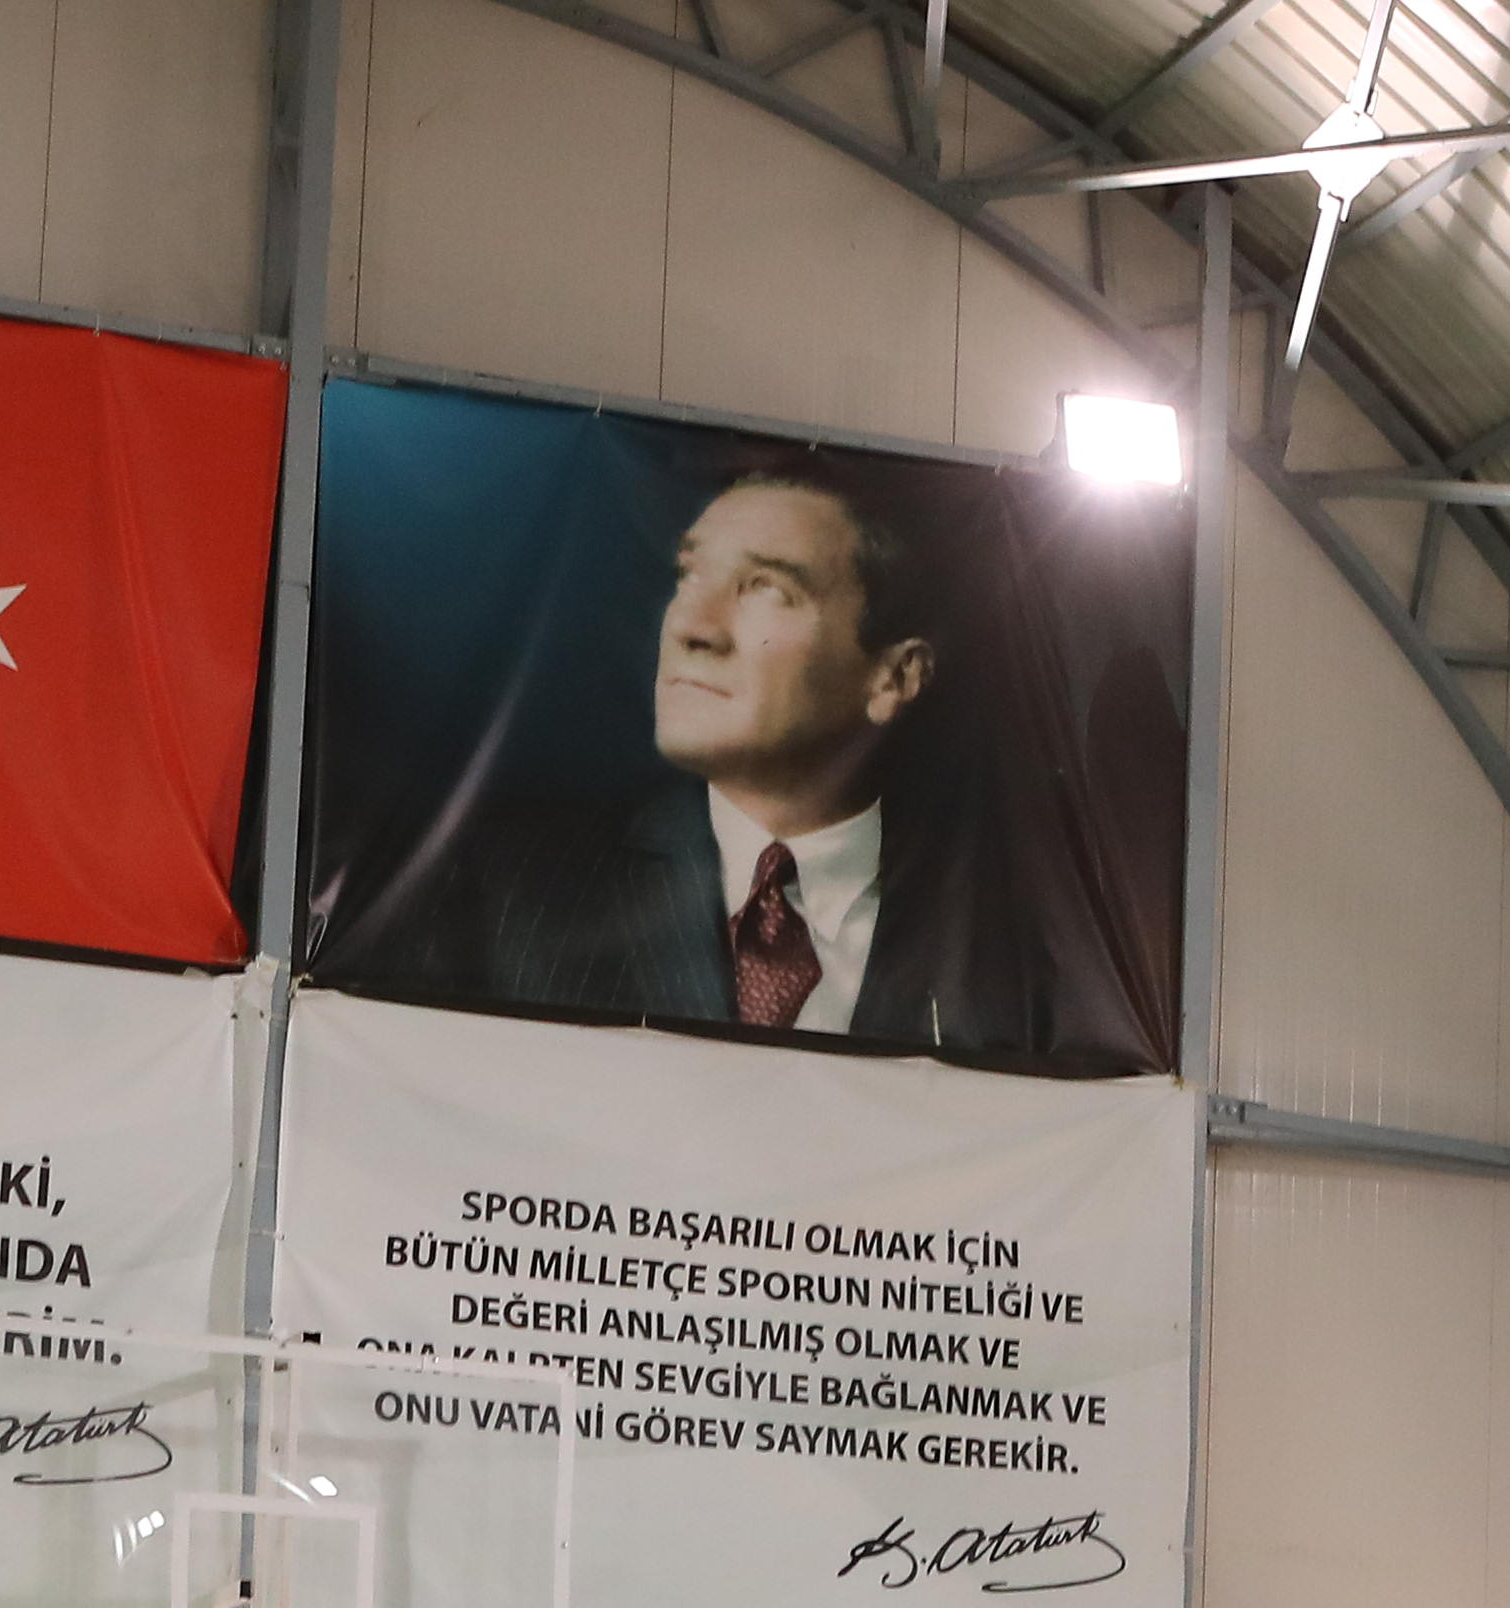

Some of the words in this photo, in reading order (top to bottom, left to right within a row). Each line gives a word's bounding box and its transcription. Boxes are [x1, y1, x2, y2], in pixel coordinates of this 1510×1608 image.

[460, 1189, 618, 1236] SPORDA
[628, 1205, 797, 1253] BAŞARILI
[803, 1222, 937, 1263] OLMAK
[946, 1227, 1020, 1277] İÇİN
[384, 1230, 520, 1278] BÜTÜN
[528, 1243, 709, 1303] MİLLETÇE
[716, 1266, 871, 1309] SPORUN
[880, 1273, 1034, 1321] NİTELİĞİ
[1040, 1290, 1085, 1325] VE
[450, 1291, 589, 1336] DEĞERİ
[598, 1306, 826, 1365] ANLAŞILMIŞ
[834, 1326, 971, 1366] OLMAK
[977, 1335, 1021, 1372] VE
[373, 1390, 460, 1427] ONU
[469, 1398, 605, 1441] VATANİ
[614, 1405, 746, 1451] GÖREV
[754, 1421, 910, 1463] SAYMAK
[916, 1433, 1080, 1476] GEREKİR.
[633, 1360, 810, 1405] SEVGİYLE
[819, 1371, 1054, 1423] BAĞLANMAK
[1060, 1392, 1107, 1427] VE
